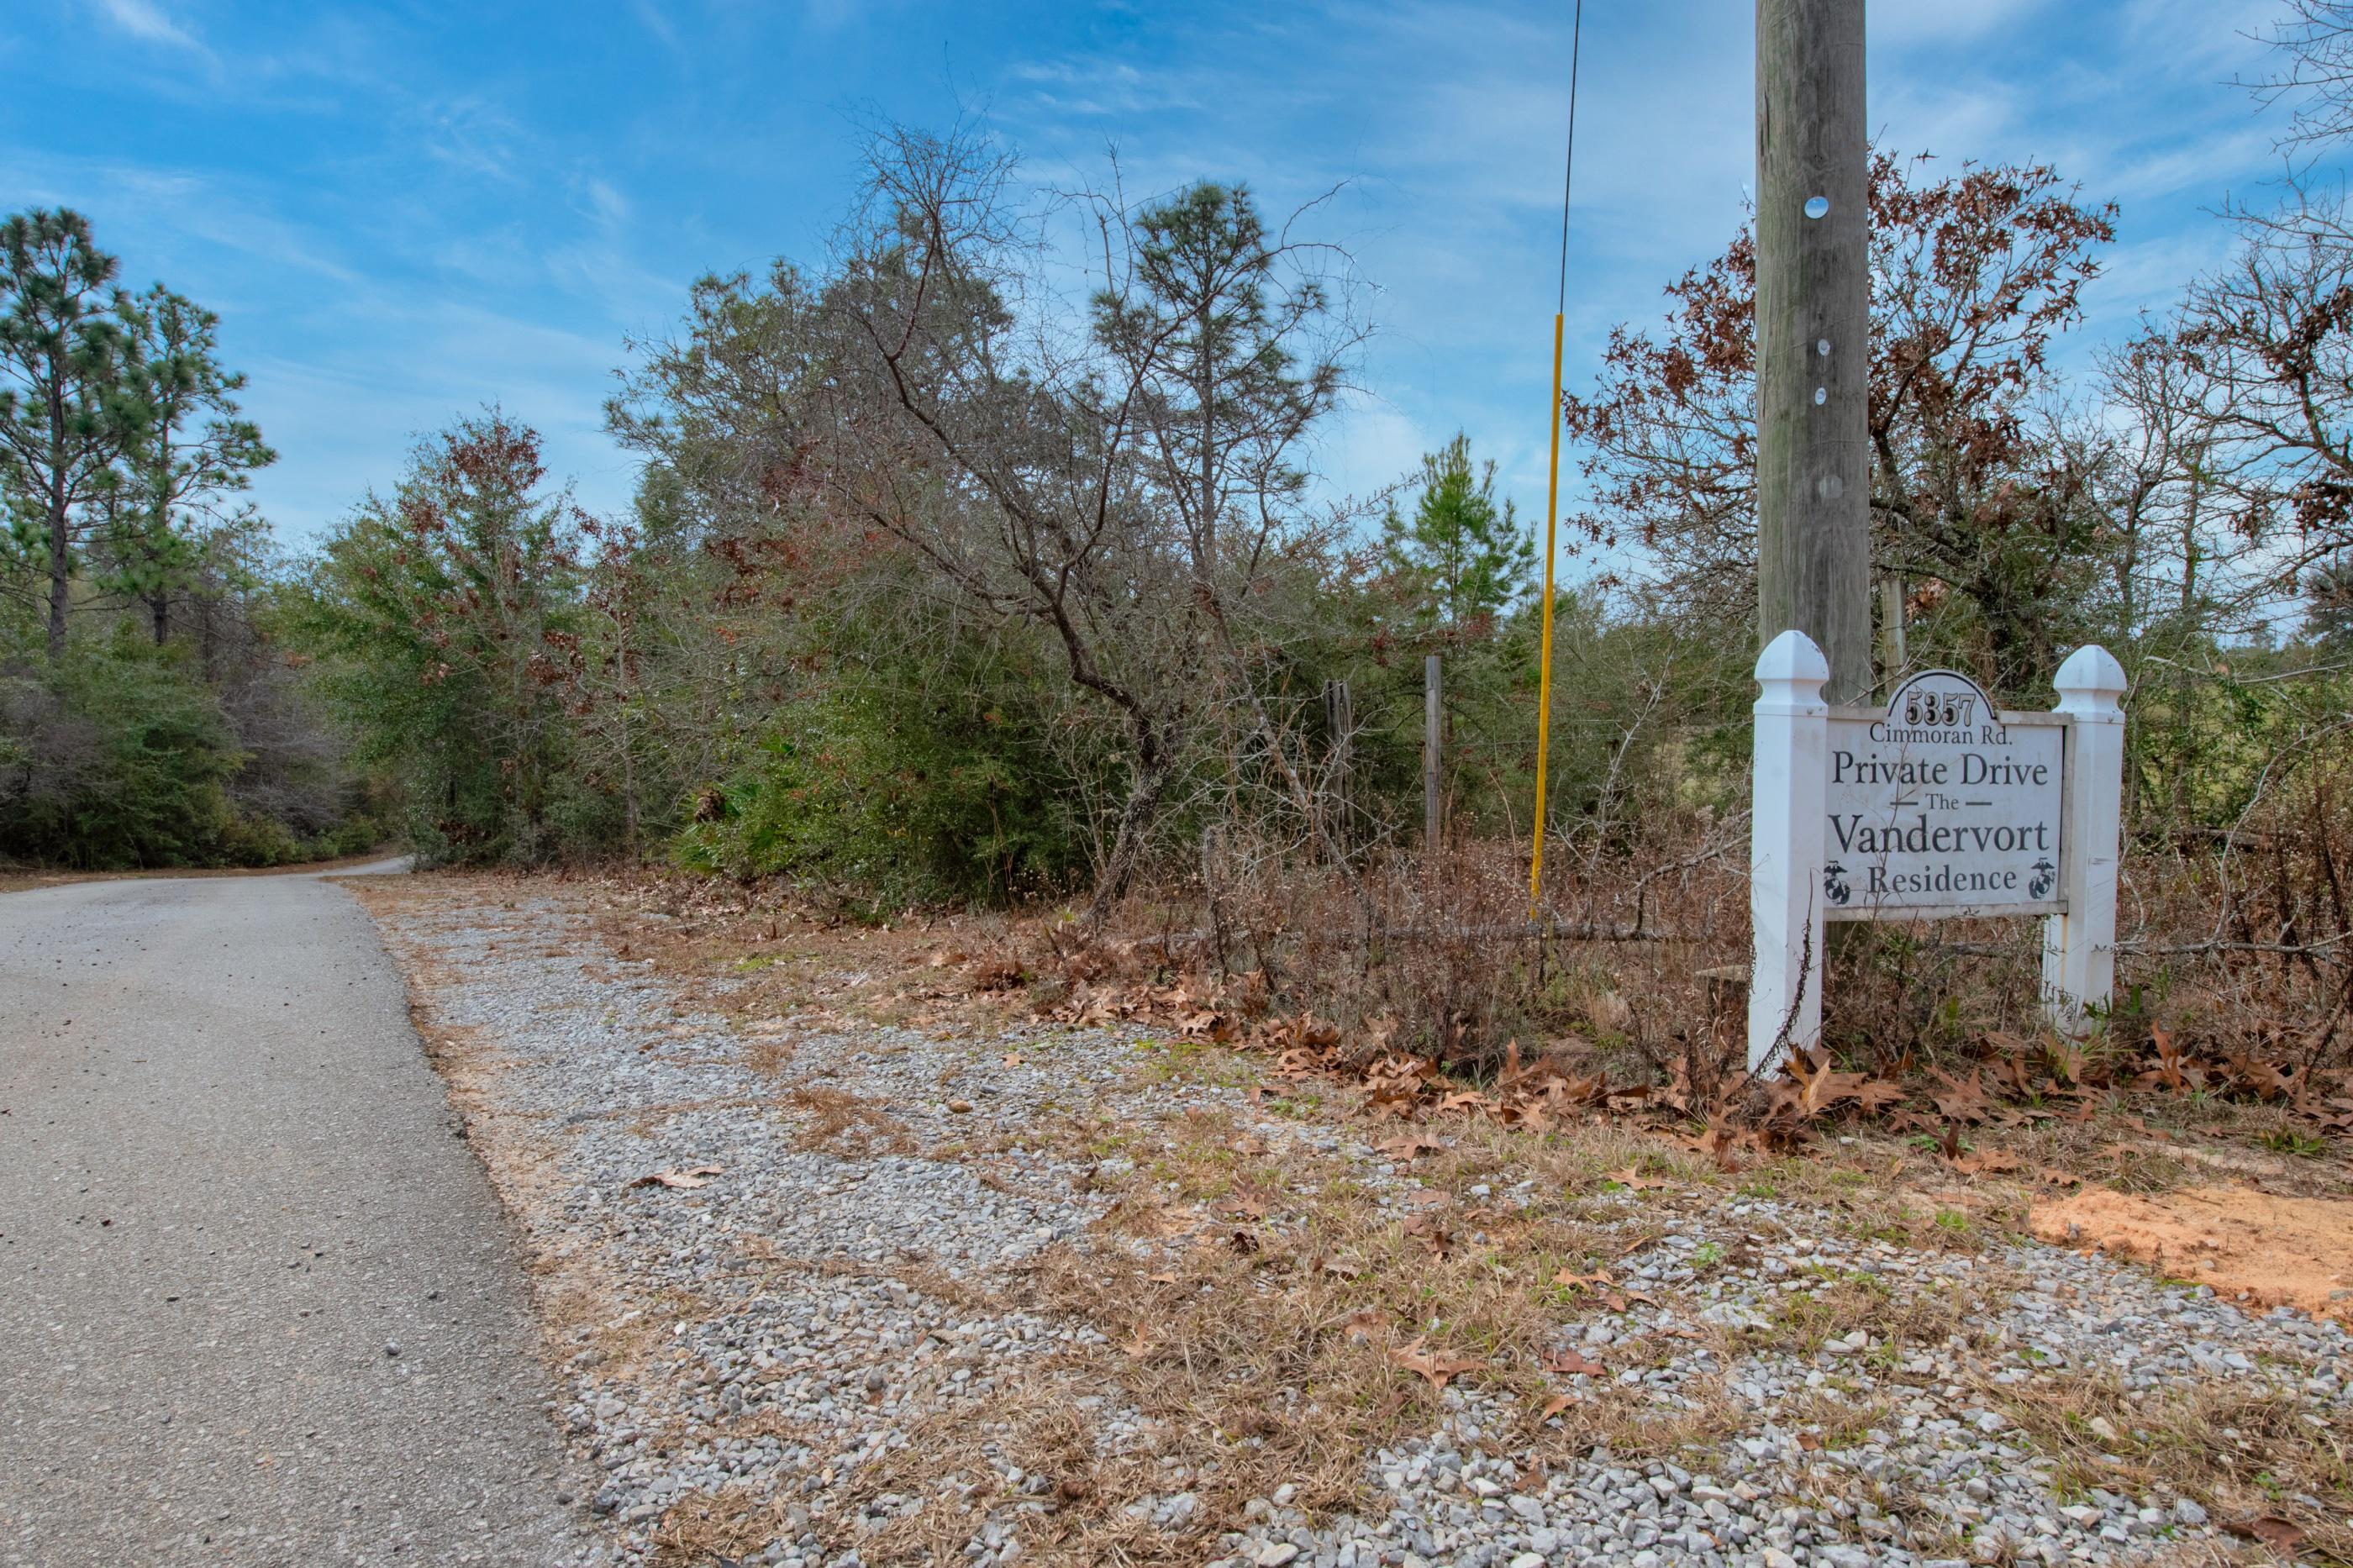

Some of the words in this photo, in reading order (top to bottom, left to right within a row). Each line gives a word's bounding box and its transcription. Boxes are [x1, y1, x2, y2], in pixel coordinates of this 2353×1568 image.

[1905, 692, 1977, 727] 5357
[1870, 722, 1973, 745] Cimmoran
[1981, 725, 2013, 745] Rd.
[1832, 750, 1948, 785] Private
[1960, 753, 2049, 786] Drive
[1924, 792, 1960, 810] The
[1827, 813, 2050, 854] Vandervort
[1867, 864, 2018, 894] Residence
